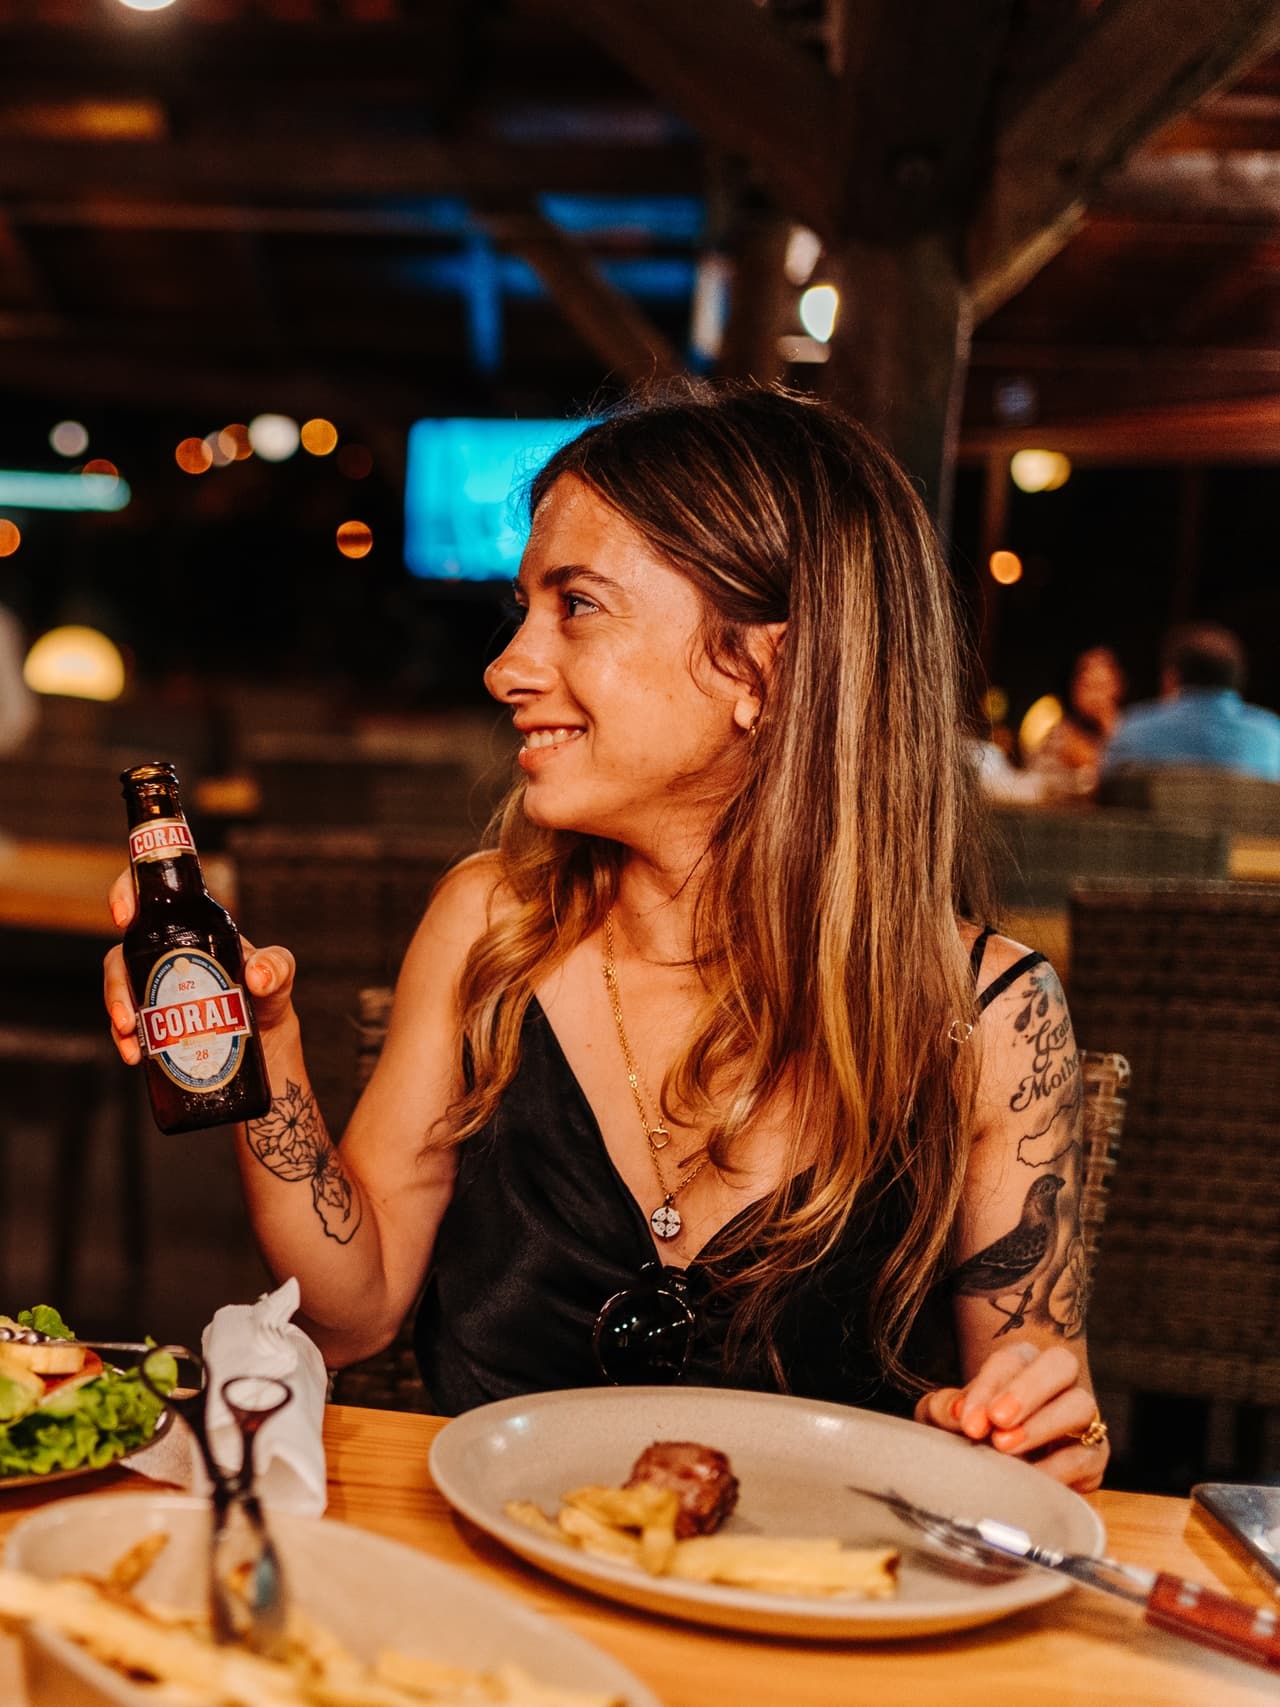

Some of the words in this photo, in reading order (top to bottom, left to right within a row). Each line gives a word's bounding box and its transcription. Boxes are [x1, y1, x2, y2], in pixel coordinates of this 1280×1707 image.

[134, 827, 190, 854] CORAL
[178, 980, 195, 991] 1872
[151, 997, 238, 1041] CORAL
[195, 1049, 209, 1061] 28
